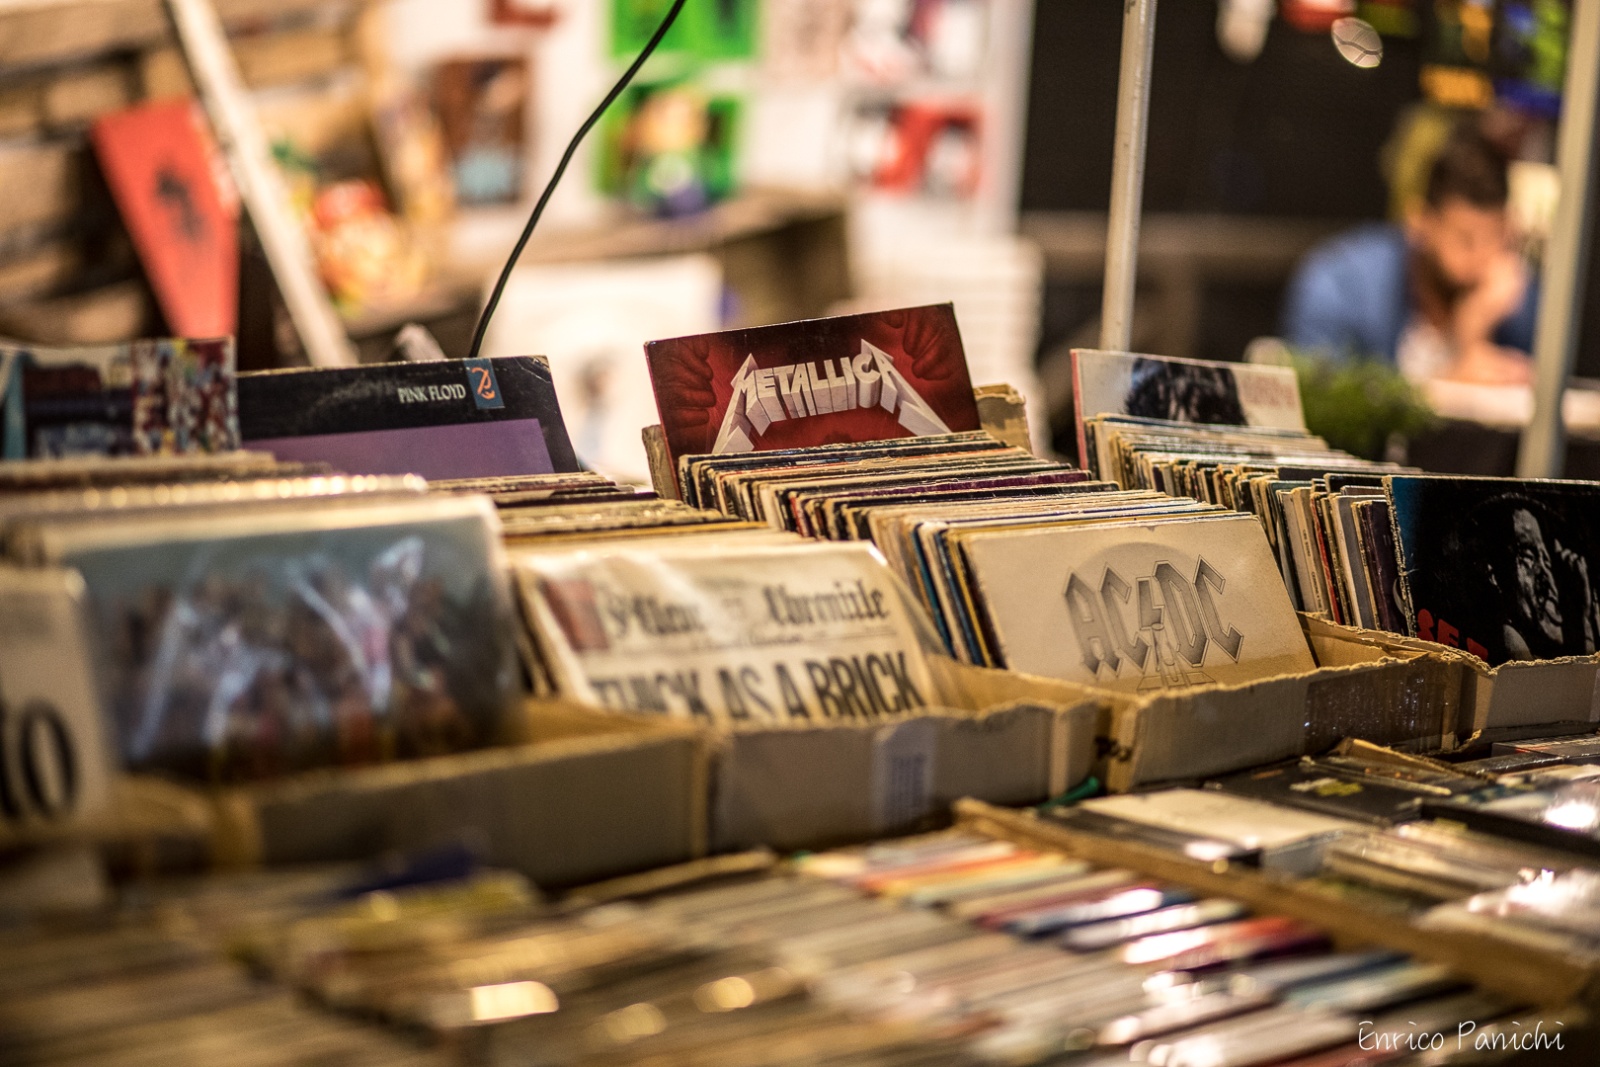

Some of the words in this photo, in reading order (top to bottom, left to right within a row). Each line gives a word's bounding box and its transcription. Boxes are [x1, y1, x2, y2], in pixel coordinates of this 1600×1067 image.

[397, 387, 429, 404] PINK
[428, 384, 467, 401] FLOYD
[712, 338, 953, 454] METALLICA
[717, 664, 779, 724] AS
[774, 661, 810, 721] A
[806, 650, 927, 720] BRICK
